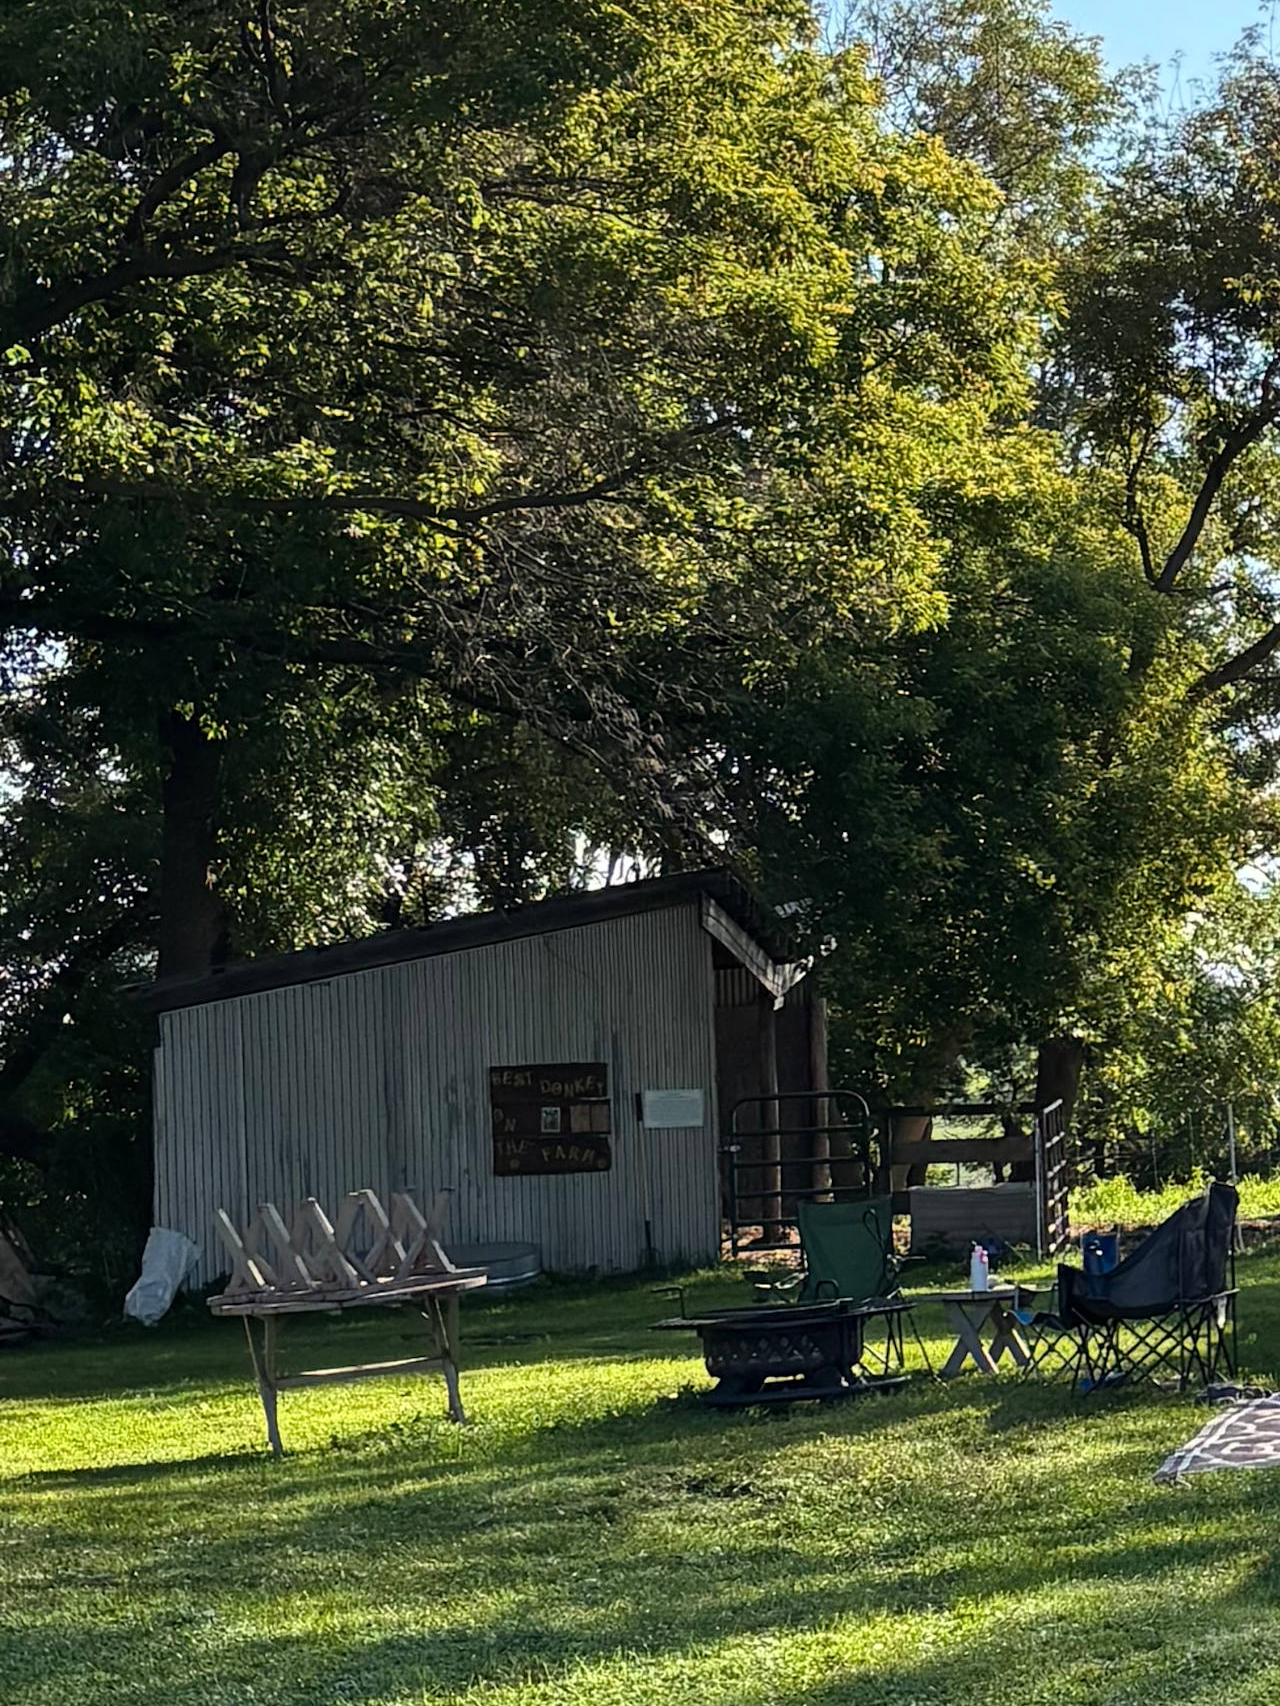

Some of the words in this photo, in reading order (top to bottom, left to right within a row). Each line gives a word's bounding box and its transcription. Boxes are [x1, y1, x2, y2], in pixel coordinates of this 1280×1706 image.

[492, 1072, 533, 1087] BEST
[541, 1076, 604, 1098] DONKEY
[494, 1108, 516, 1132] ON
[496, 1140, 535, 1155] THE
[542, 1145, 595, 1162] FARM
